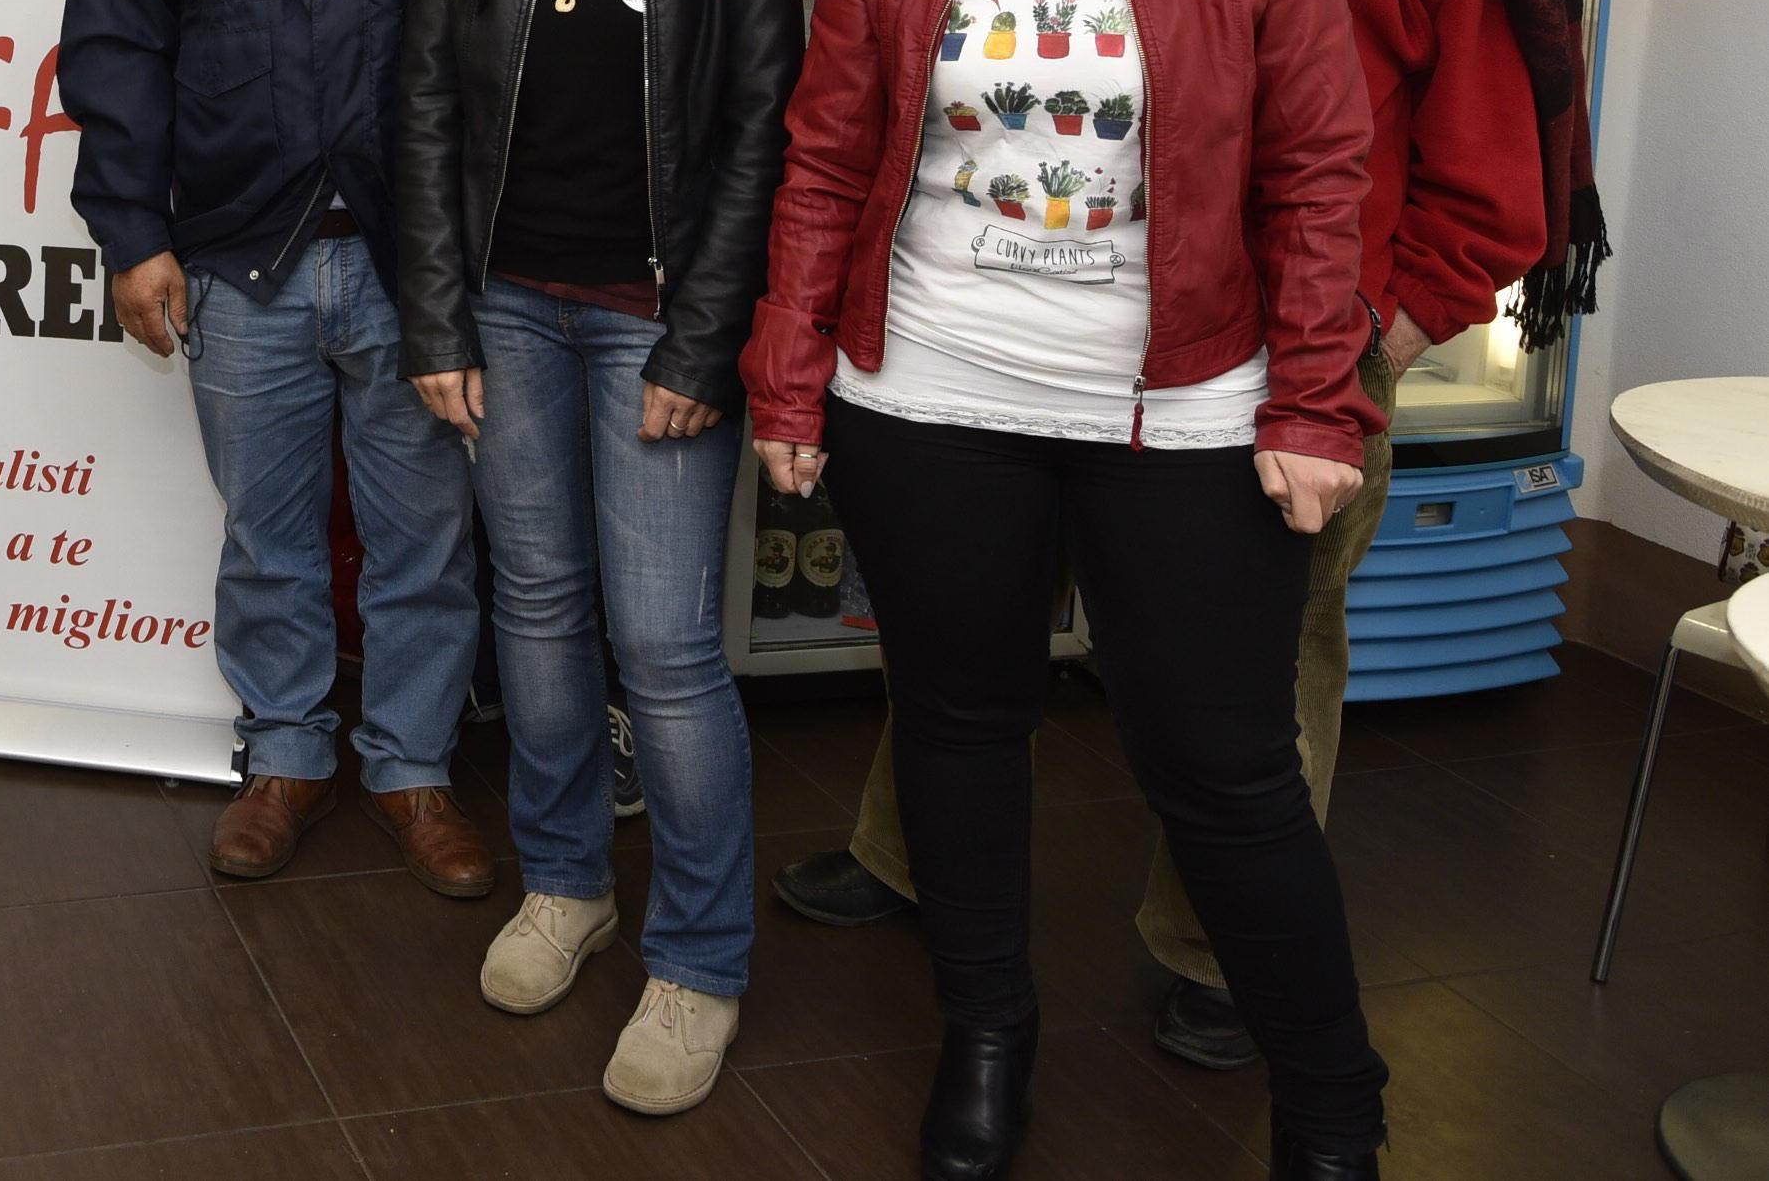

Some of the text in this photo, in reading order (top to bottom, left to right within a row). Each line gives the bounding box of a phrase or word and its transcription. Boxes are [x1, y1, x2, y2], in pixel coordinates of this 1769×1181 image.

[996, 239, 1095, 266] CURVY PLANTS
[6, 531, 34, 562] a
[49, 529, 93, 567] te
[6, 599, 211, 649] migliore
